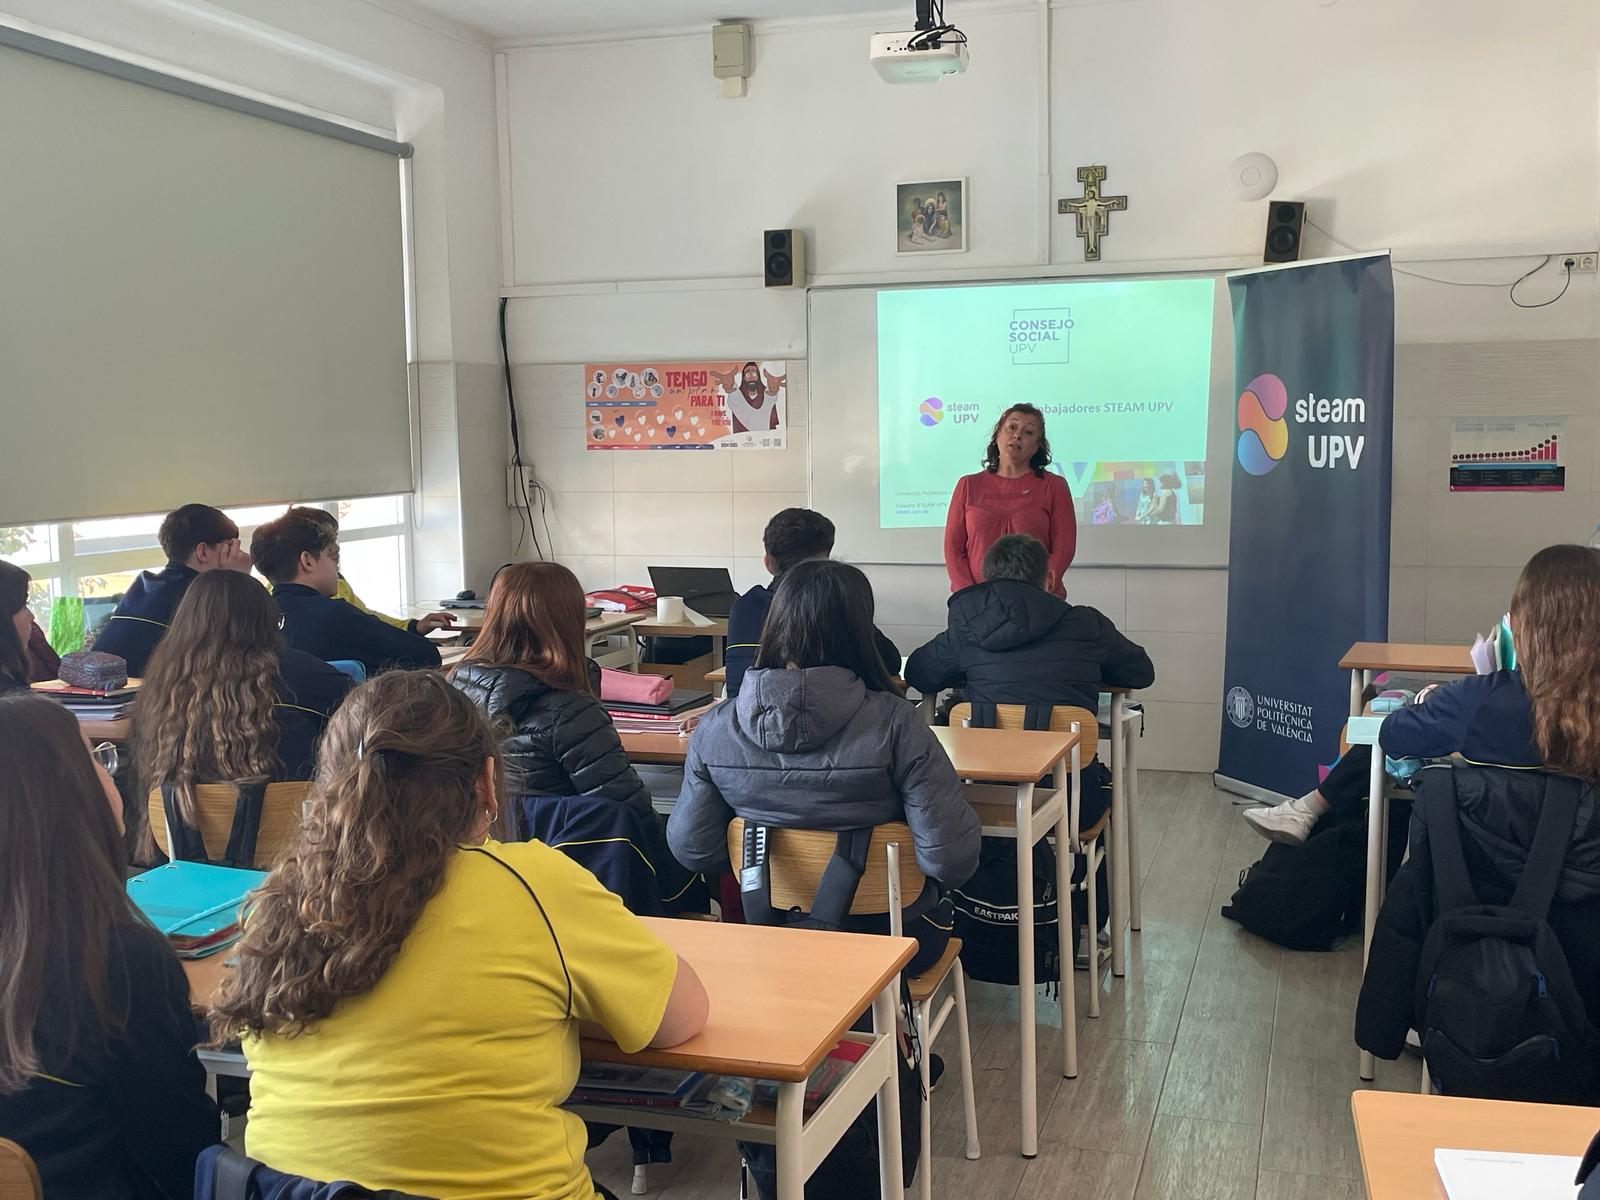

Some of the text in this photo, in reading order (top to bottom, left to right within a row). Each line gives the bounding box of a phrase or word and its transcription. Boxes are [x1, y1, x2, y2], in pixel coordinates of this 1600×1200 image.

[1010, 319, 1075, 331] CONSEJO
[1009, 331, 1060, 342] SOCIAL
[1009, 343, 1036, 354] UPV
[665, 371, 708, 389] TENGO
[690, 394, 725, 408] PARA TI
[947, 402, 980, 412] steam
[1103, 402, 1145, 412] STEAM
[1147, 401, 1174, 412] UPV
[1295, 392, 1366, 424] steam
[953, 413, 980, 424] UPV
[1308, 434, 1365, 470] UPV
[1257, 694, 1313, 717] UNIVERSITAT
[1256, 707, 1313, 730] POLITÈCNICA
[1256, 719, 1313, 743] DE VALÈNCIA
[974, 906, 1019, 921] EASTPAK
